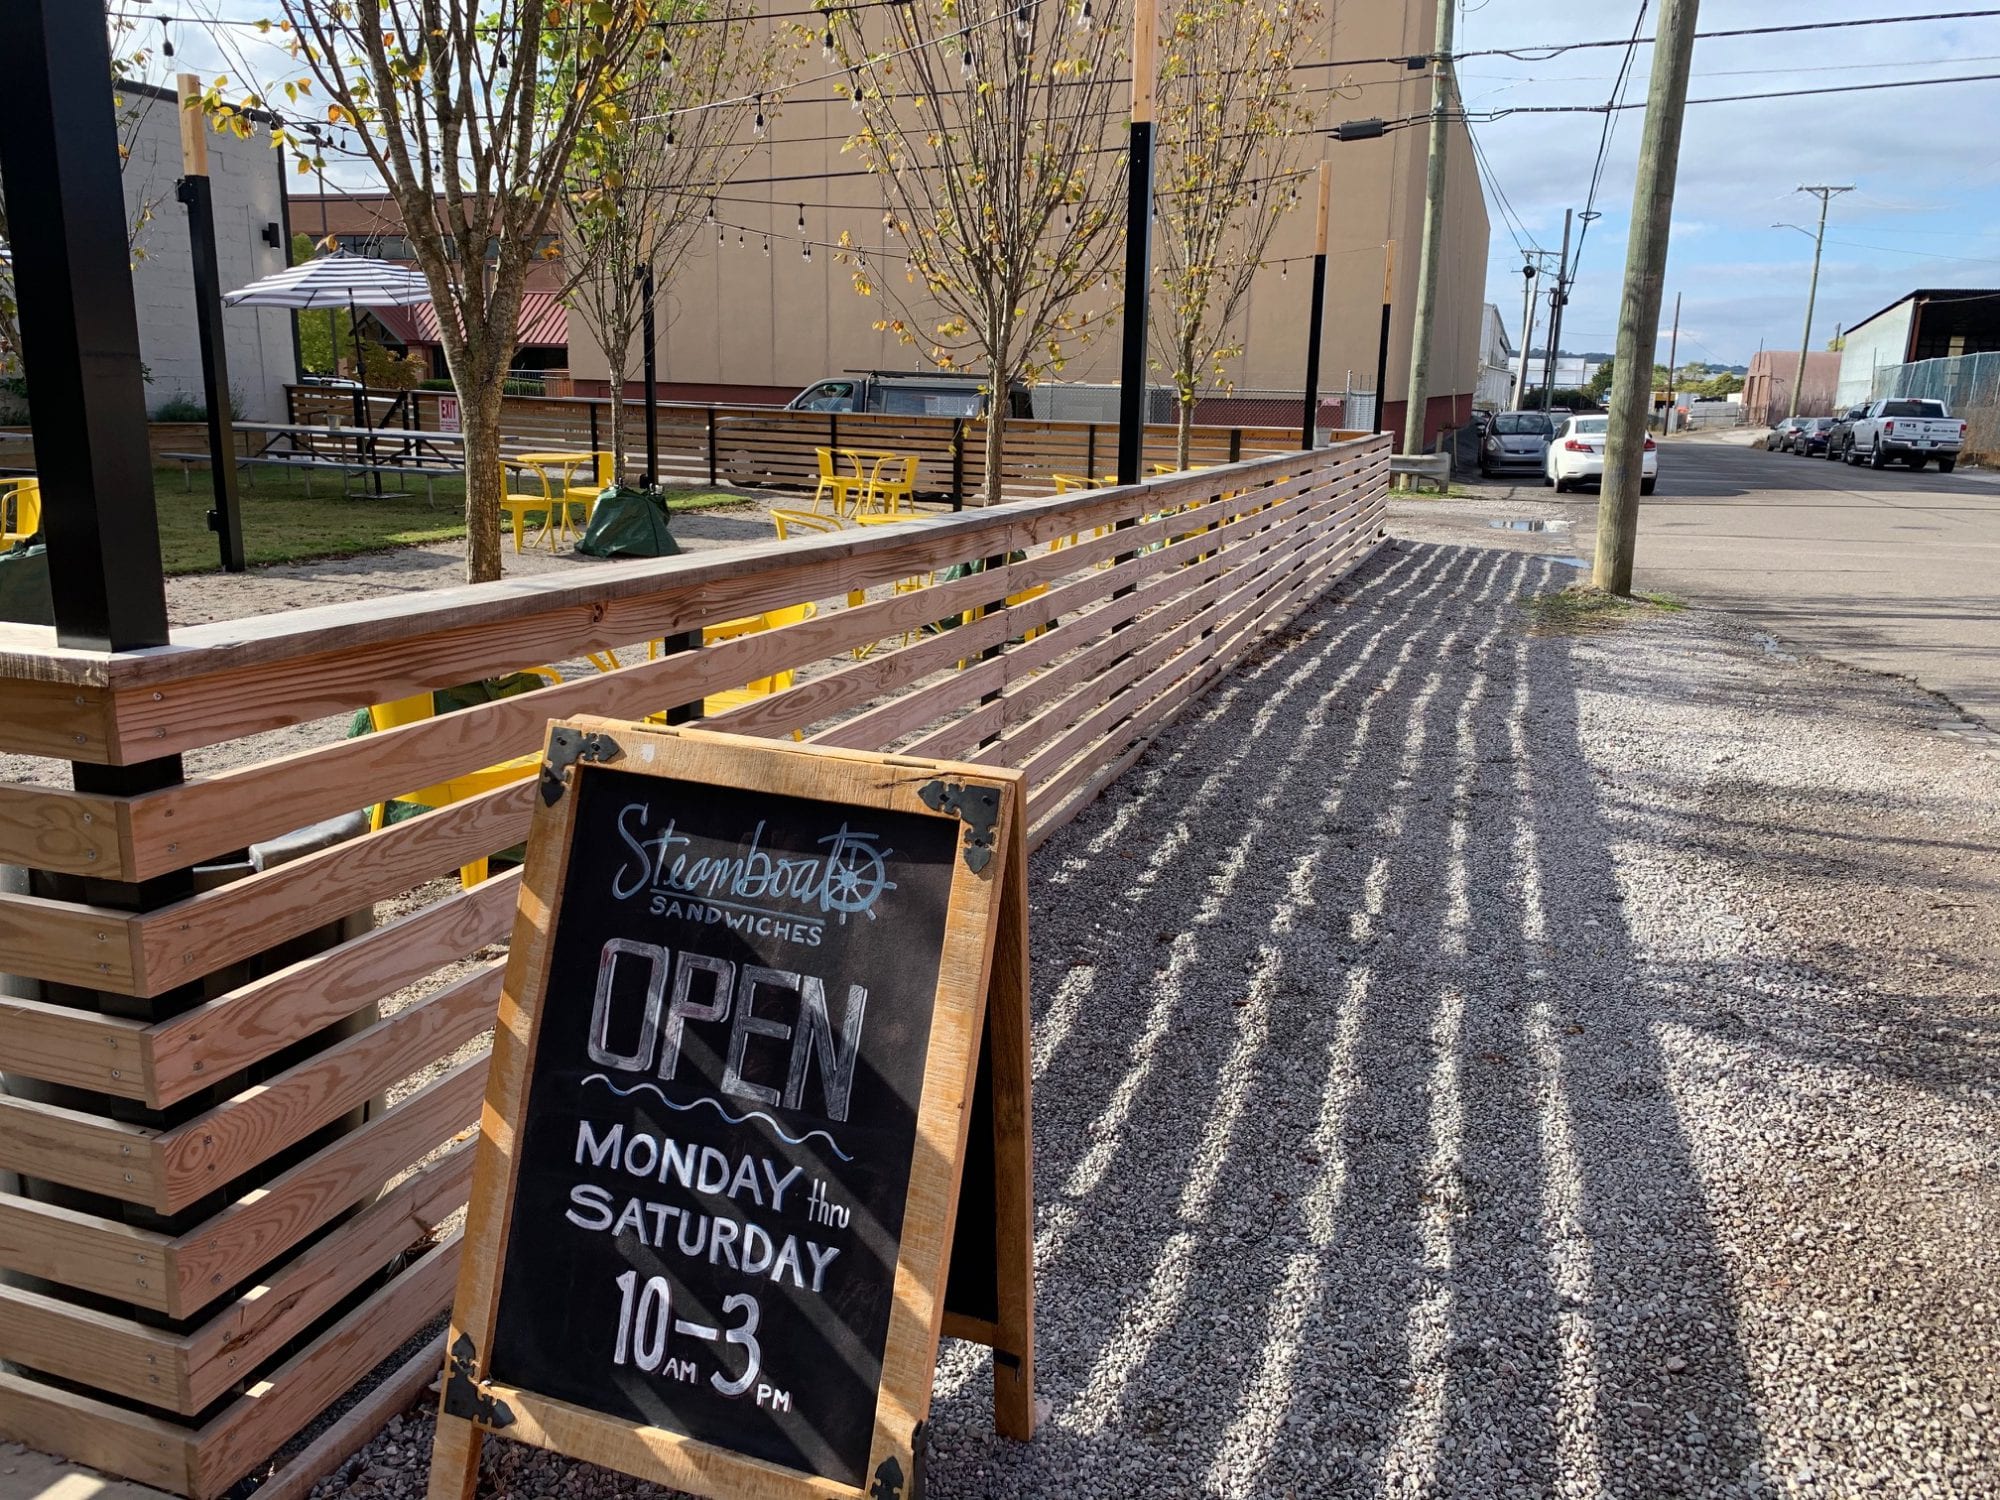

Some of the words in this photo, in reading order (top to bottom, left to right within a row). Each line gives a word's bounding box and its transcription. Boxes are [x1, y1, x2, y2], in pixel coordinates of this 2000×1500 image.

[441, 400, 457, 419] EXIT
[612, 802, 882, 912] Steamboat
[650, 896, 823, 947] SANDWICHES
[588, 937, 868, 1122] OPEN
[575, 1119, 803, 1213] MONDAY
[808, 1178, 851, 1229] thru
[565, 1183, 841, 1293] SATURDAY
[663, 1356, 697, 1383] AM
[756, 1383, 792, 1413] PM
